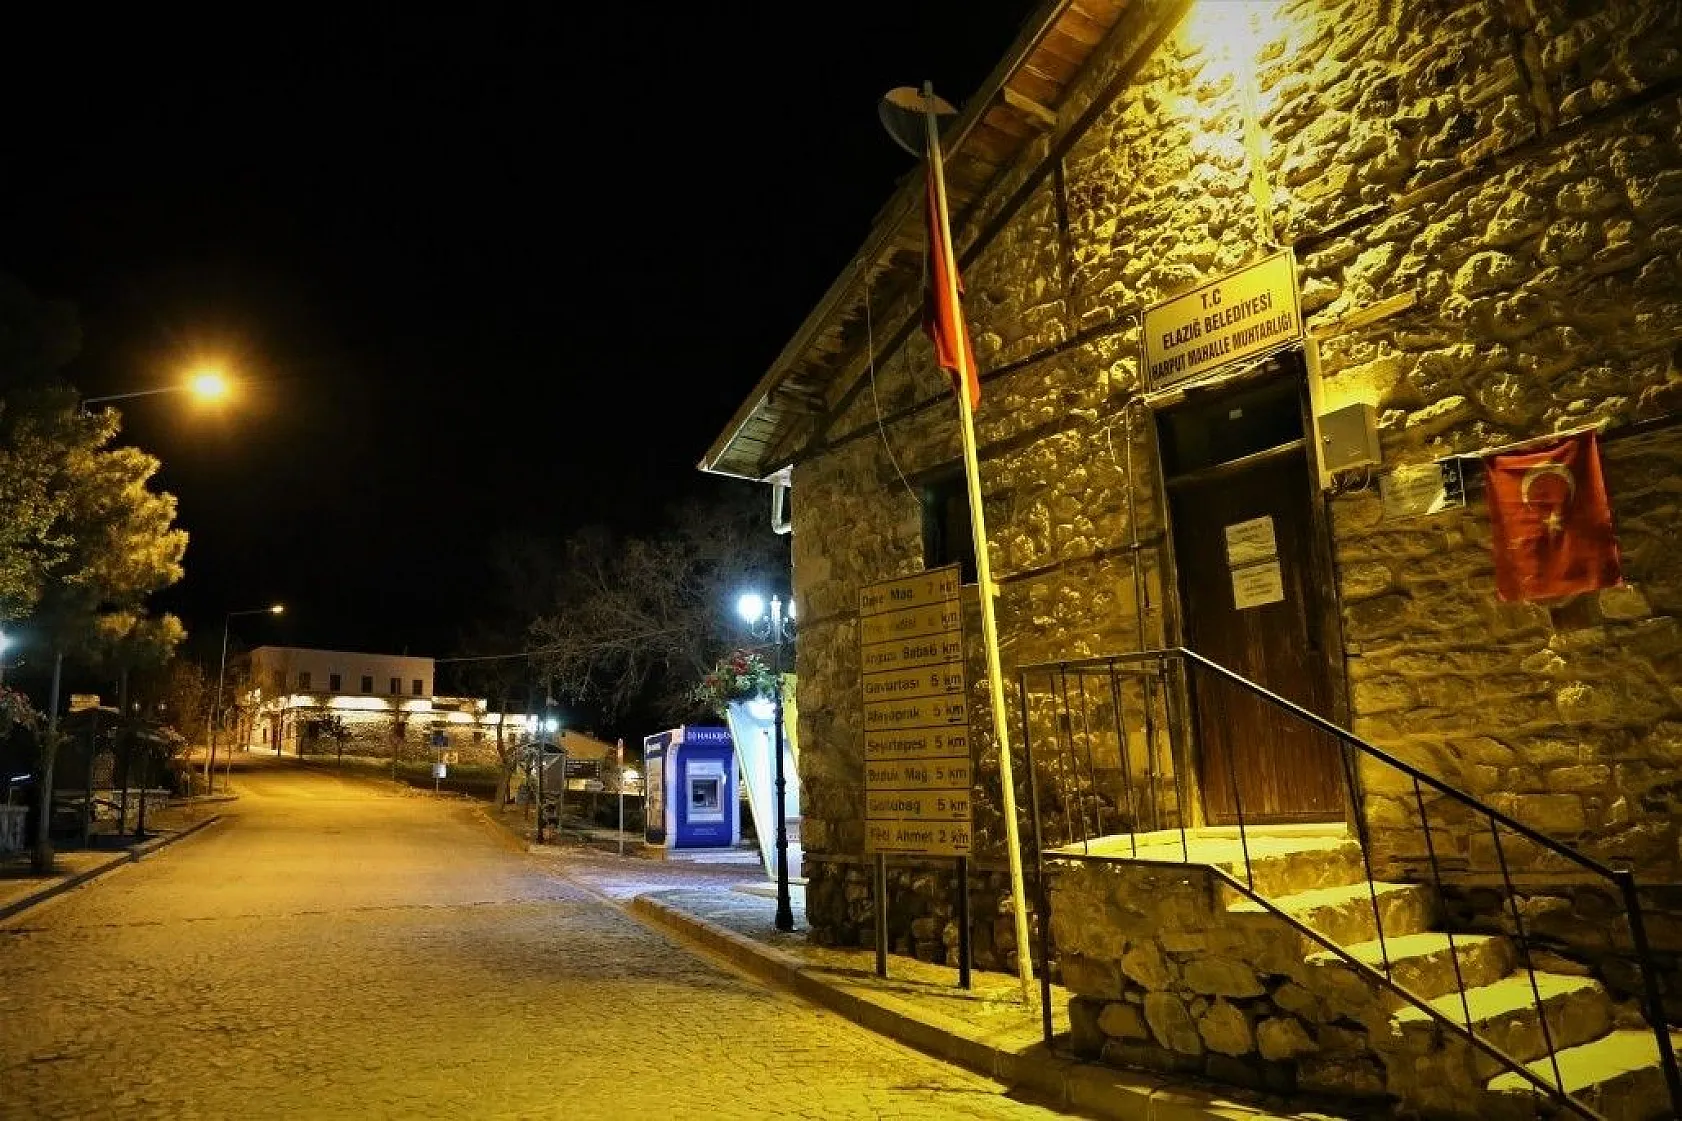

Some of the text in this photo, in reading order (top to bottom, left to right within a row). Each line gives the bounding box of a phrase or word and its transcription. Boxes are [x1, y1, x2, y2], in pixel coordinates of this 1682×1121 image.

[1201, 288, 1222, 309] T.C
[1163, 289, 1273, 350] ELAZIĞ BELEDİYESİ
[1152, 311, 1292, 379] HARPUT MAHALLE MUHTARLIĞI
[941, 611, 957, 623] km
[942, 641, 960, 654] km
[944, 673, 962, 686] km
[946, 702, 964, 715] km
[934, 735, 942, 749] 5
[947, 734, 966, 747] km
[936, 767, 944, 780] 5
[949, 767, 967, 779] km
[950, 798, 968, 811] km
[938, 829, 947, 843] 2
